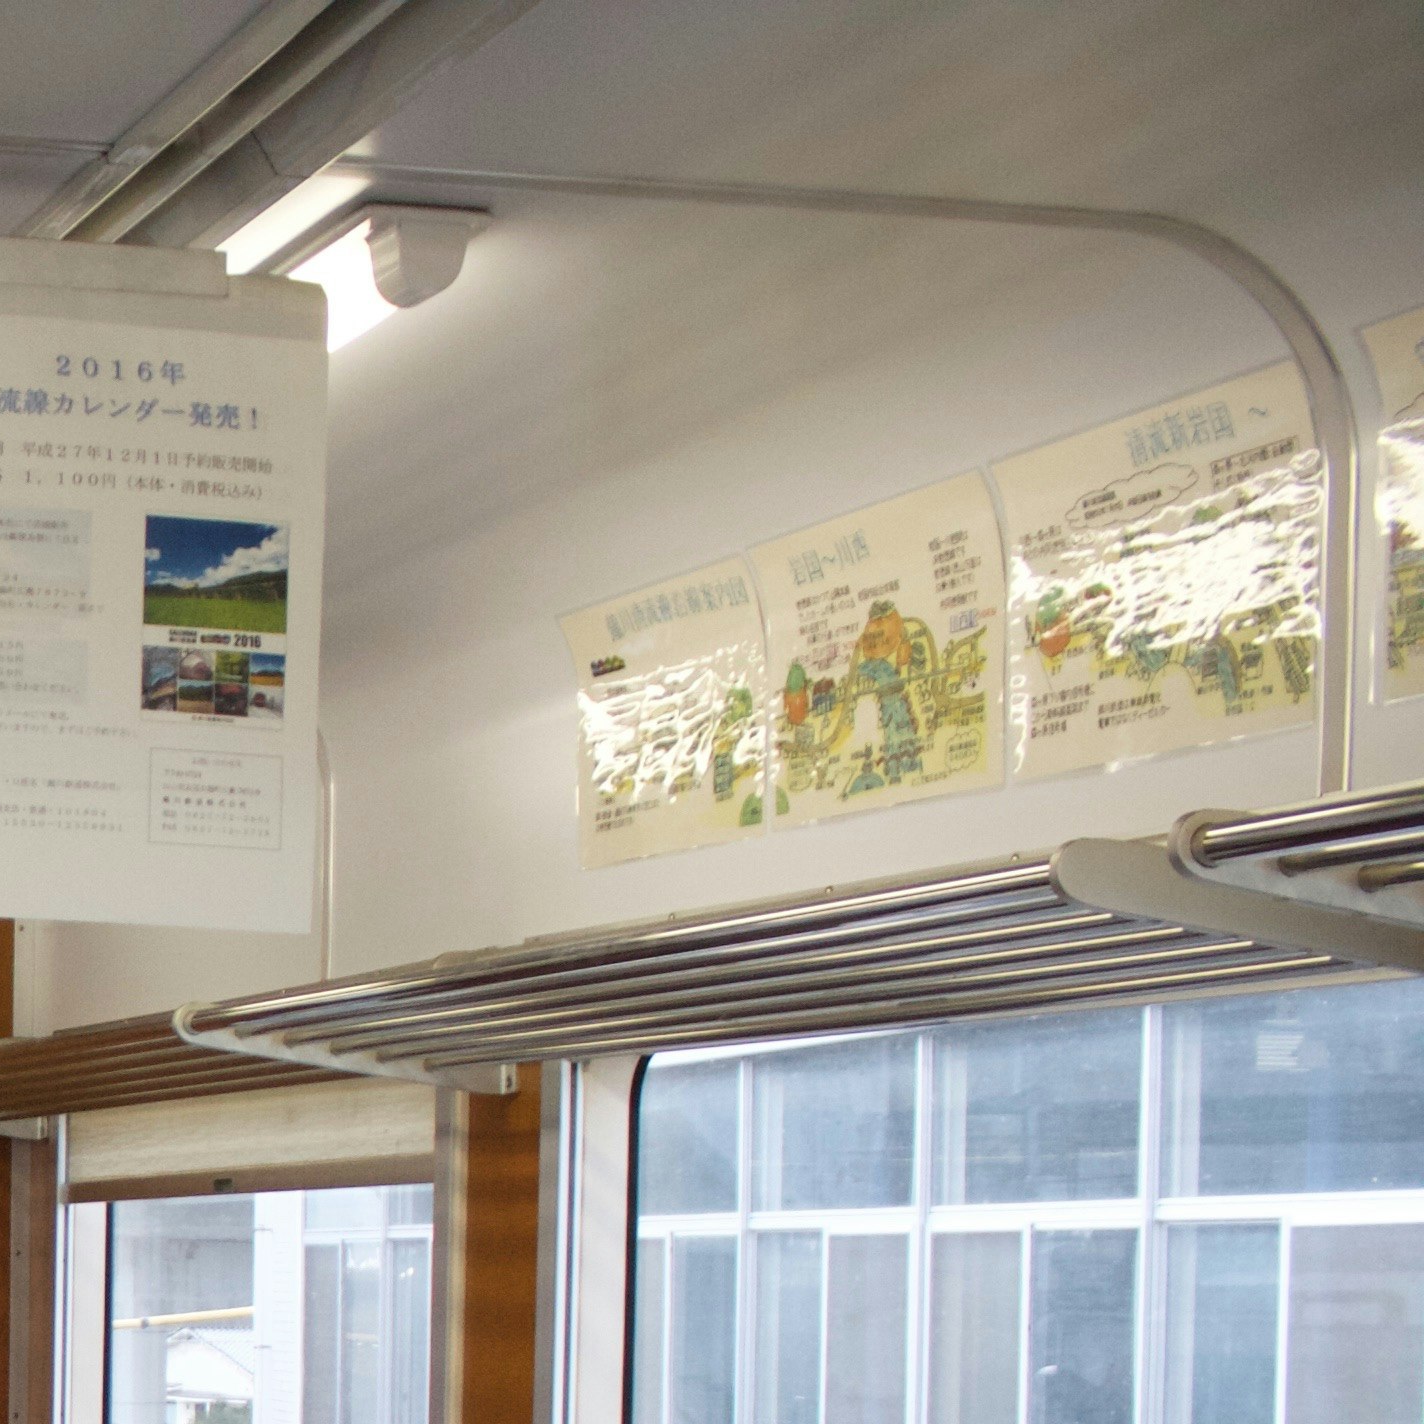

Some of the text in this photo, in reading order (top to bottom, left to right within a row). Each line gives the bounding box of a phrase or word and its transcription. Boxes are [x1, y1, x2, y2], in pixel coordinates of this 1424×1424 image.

[55, 353, 187, 386] 2016年
[1124, 400, 1236, 468] 清流新岩国
[234, 633, 262, 649] 2016
